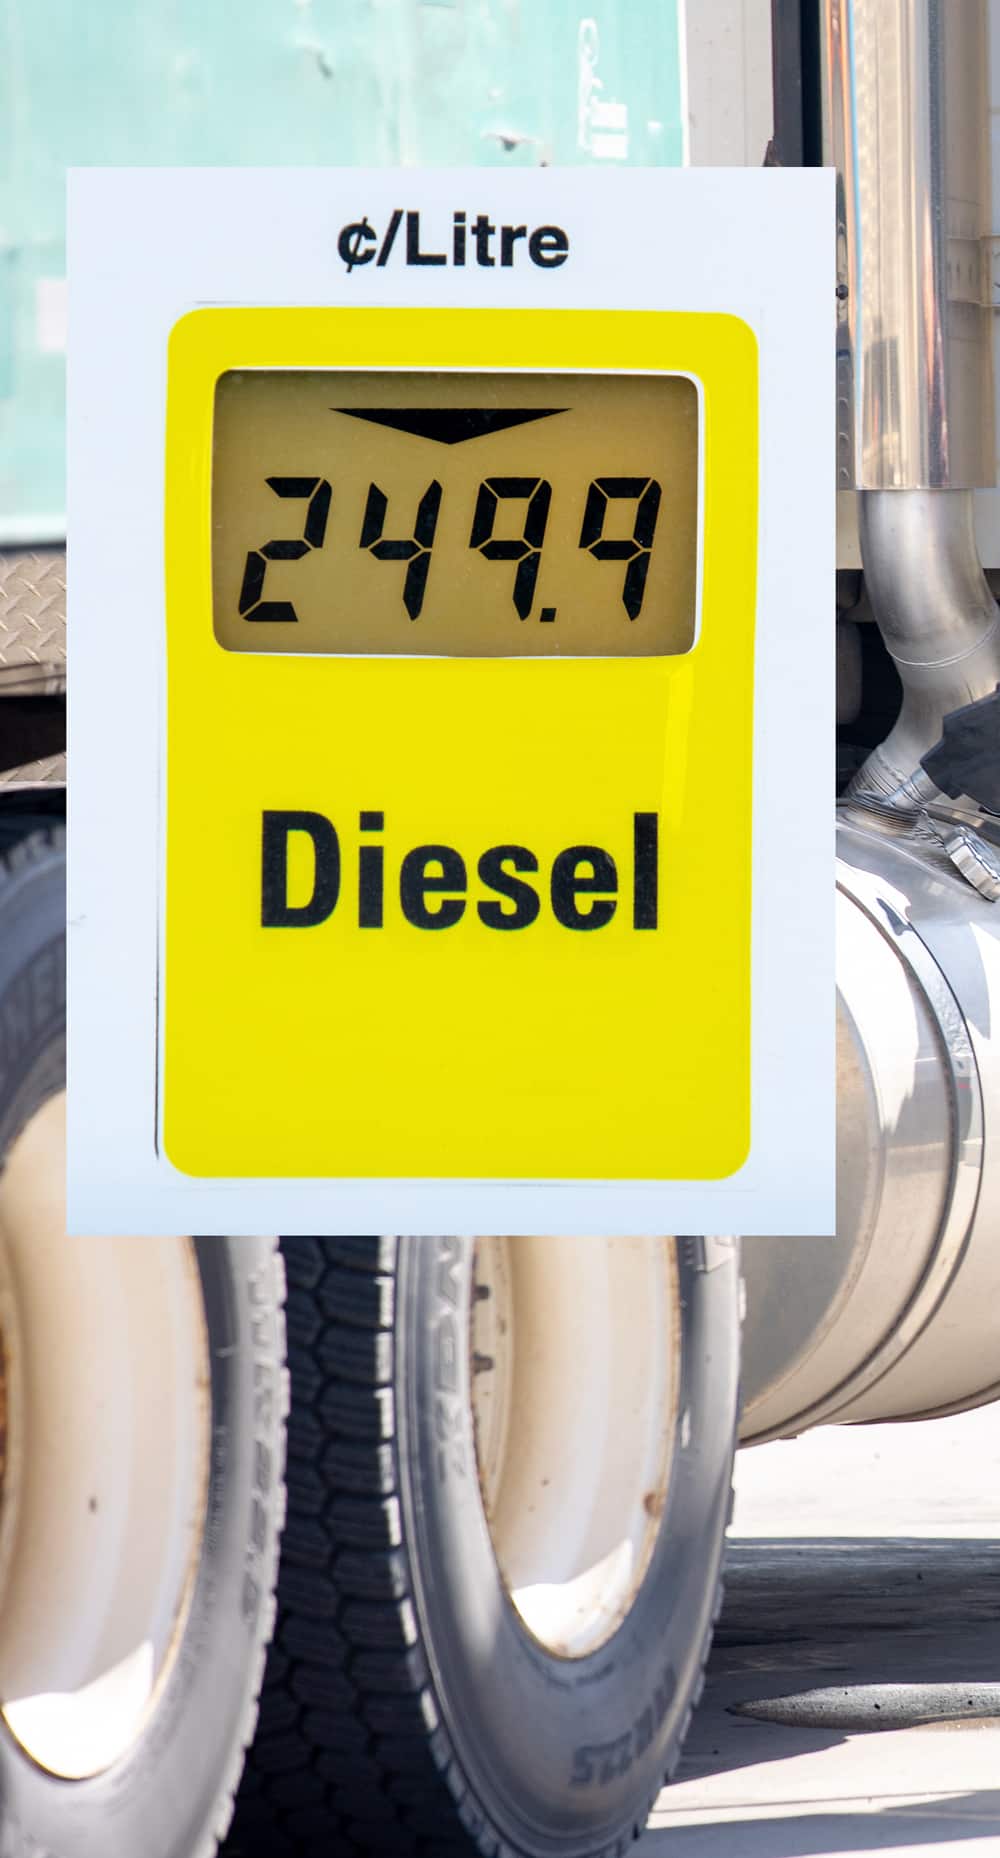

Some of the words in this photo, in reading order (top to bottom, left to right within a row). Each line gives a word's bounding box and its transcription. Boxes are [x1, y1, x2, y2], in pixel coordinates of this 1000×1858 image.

[337, 210, 569, 273] ¢/Litre
[238, 475, 664, 623] 249.9
[261, 809, 659, 932] Diesel
